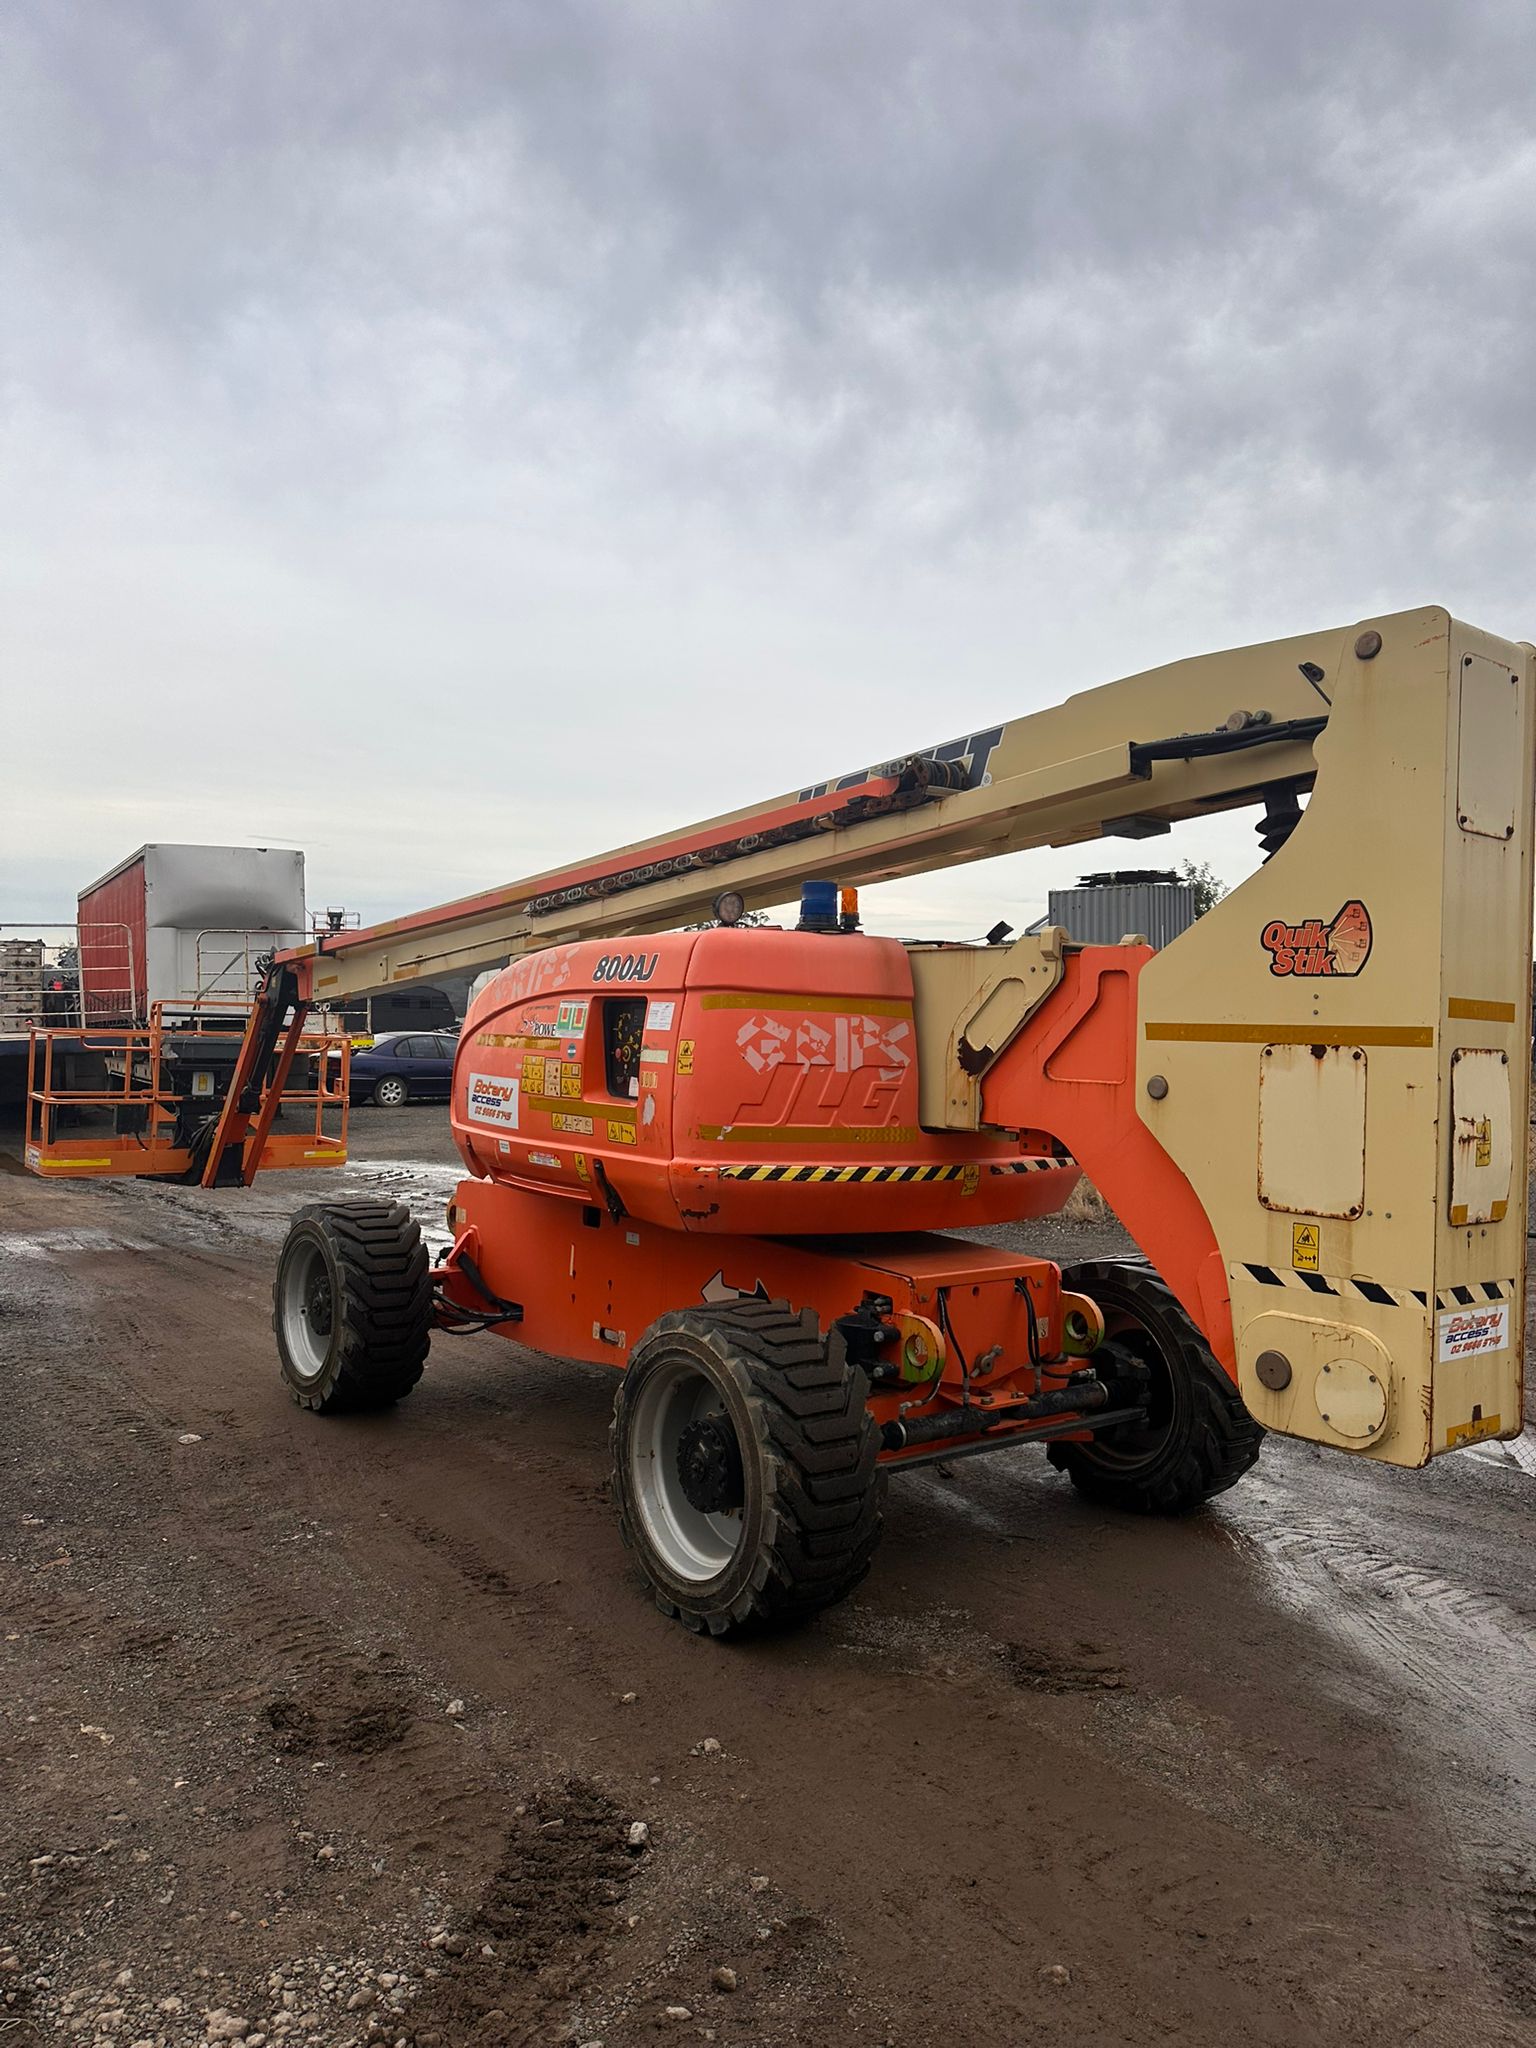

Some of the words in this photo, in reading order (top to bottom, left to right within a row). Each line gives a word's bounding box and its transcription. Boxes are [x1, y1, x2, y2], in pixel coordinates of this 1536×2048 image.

[1263, 921, 1331, 951] Quik
[592, 953, 660, 982] 800AJ
[1272, 948, 1335, 974] Stik
[472, 1094, 502, 1107] access
[474, 1079, 513, 1102] Botany
[1448, 1312, 1503, 1333] Botany
[1445, 1327, 1489, 1344] access
